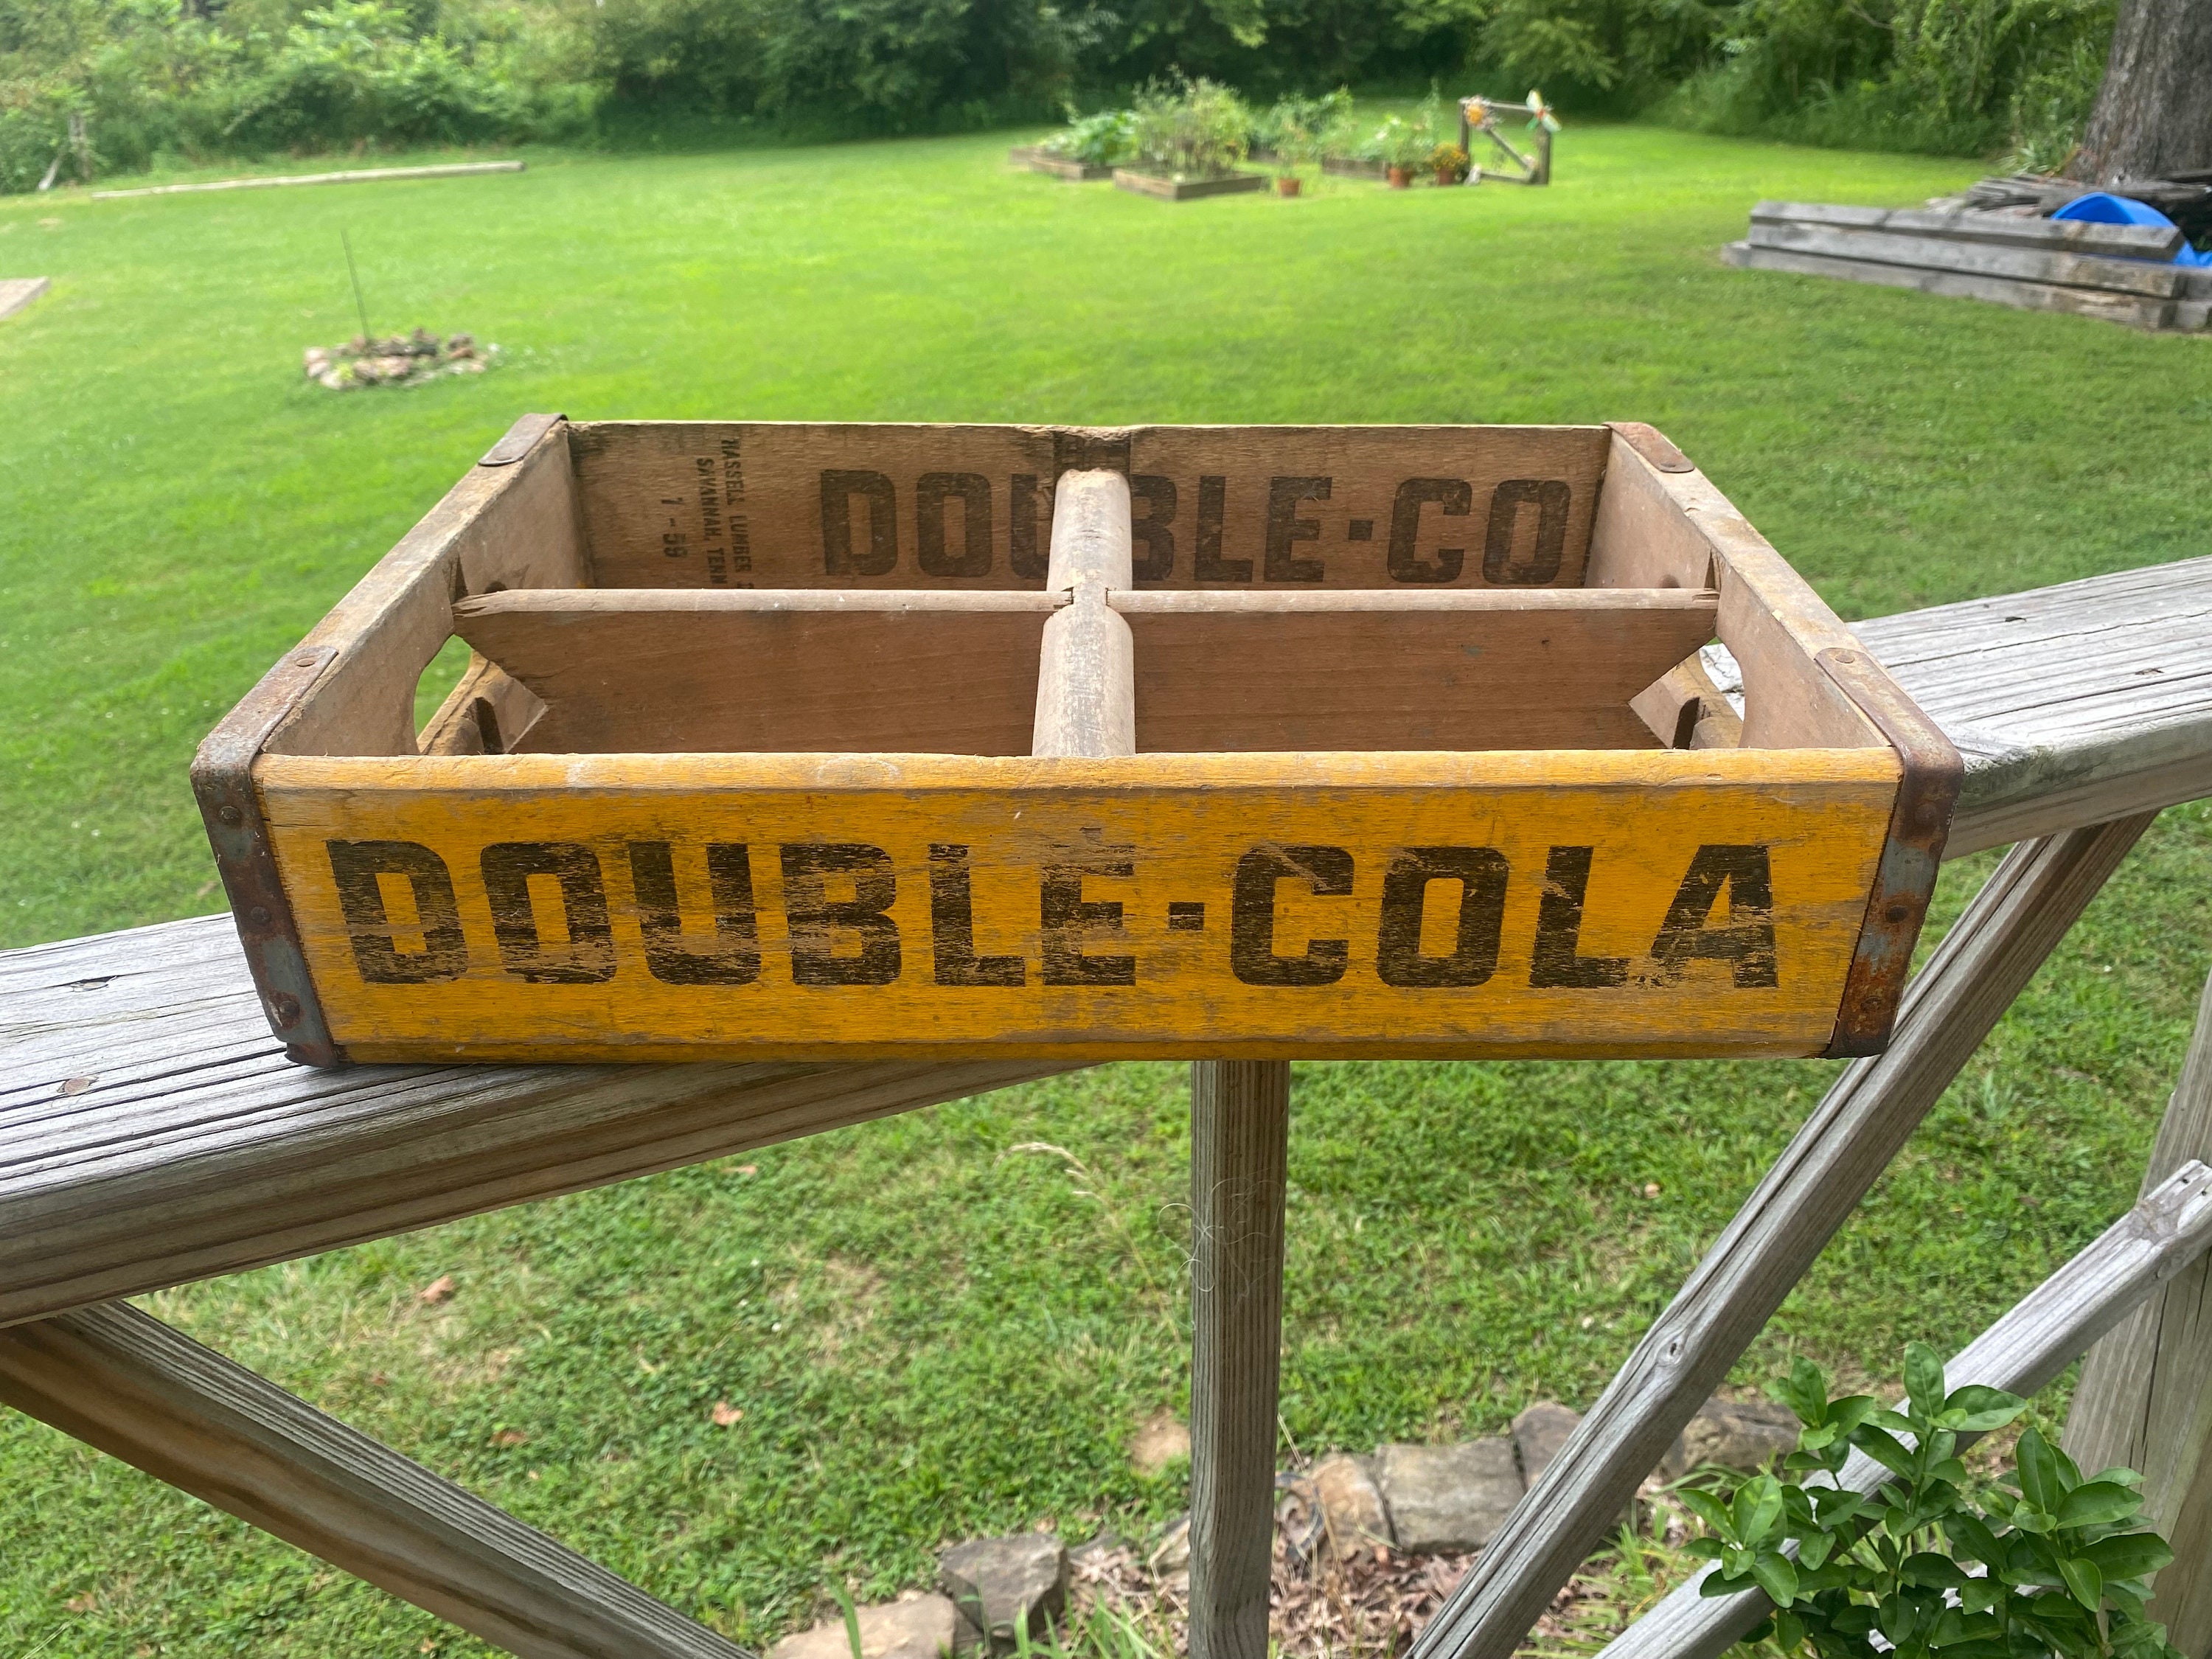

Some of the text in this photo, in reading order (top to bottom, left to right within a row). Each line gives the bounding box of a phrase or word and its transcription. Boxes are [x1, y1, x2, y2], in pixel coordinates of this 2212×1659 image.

[729, 515, 753, 572] LUMBER
[820, 470, 1604, 585] DOUBLE-CO
[326, 839, 1779, 989] DOUBLE-COLA
